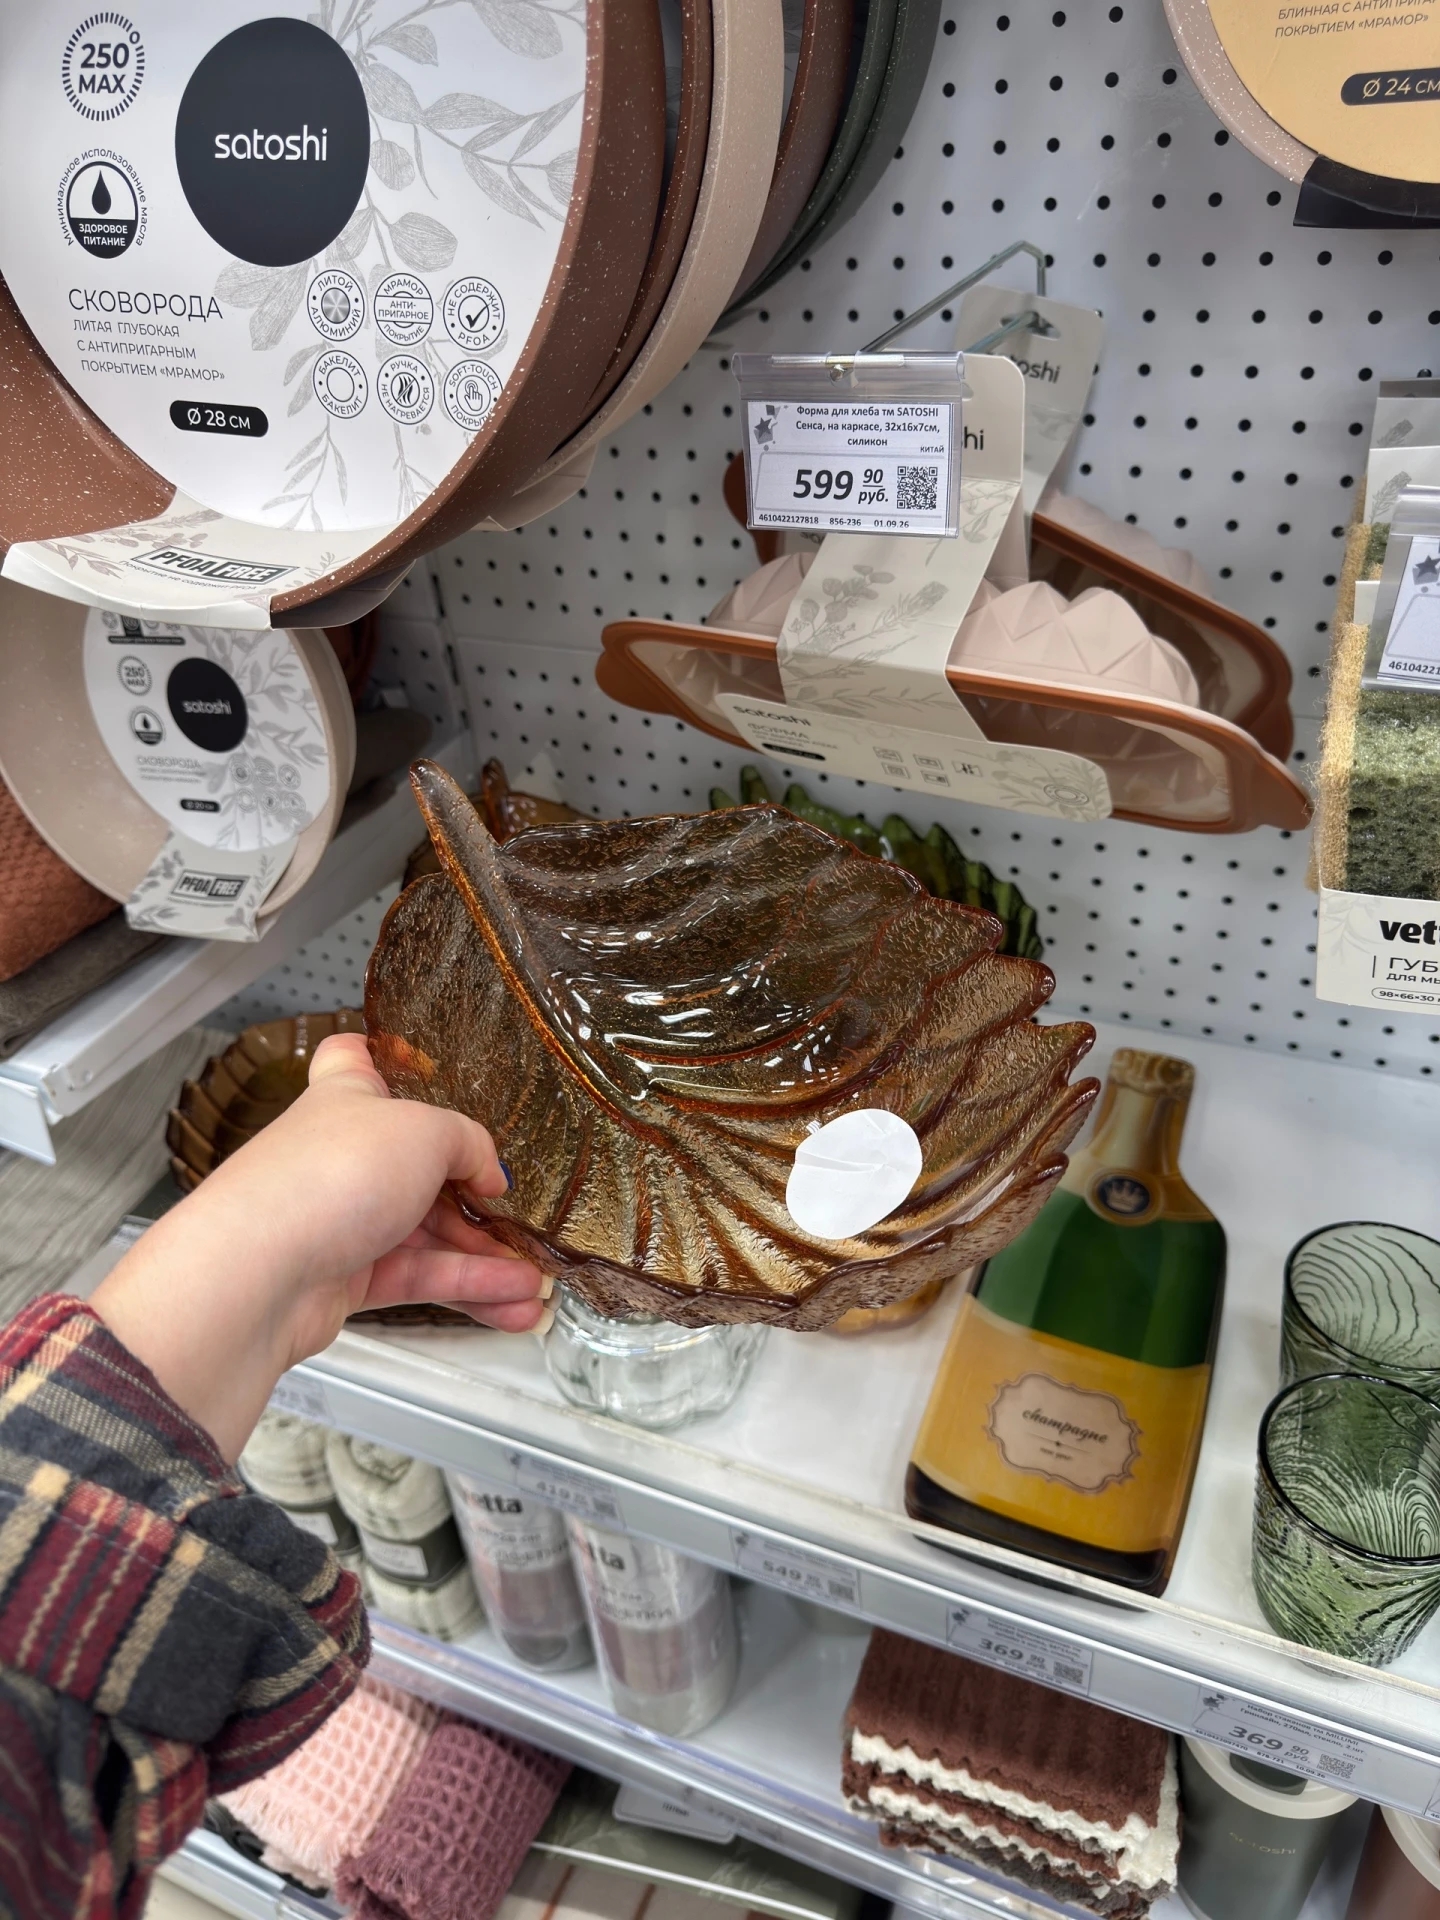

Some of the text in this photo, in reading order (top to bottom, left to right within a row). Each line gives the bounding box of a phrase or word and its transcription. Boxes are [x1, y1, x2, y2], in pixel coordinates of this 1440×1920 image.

[1278, 3, 1339, 20] БЛИННАЯ
[1274, 13, 1429, 38] ПОКРЫТИЕМ «МРАМОР»
[78, 73, 127, 94] MAX
[1384, 77, 1412, 96] 24
[214, 124, 328, 162] satoshi
[57, 148, 148, 247] Минимальное использование масла
[78, 223, 128, 234] ЗДОРОВОЕ
[83, 236, 126, 247] ПИТАНИЕ
[317, 274, 354, 292] ЛИТОЙ
[383, 278, 424, 296] МРАМОР
[68, 288, 224, 323] СКОВОРОДА
[389, 300, 417, 309] АНТИ-
[447, 282, 501, 320] НЕ СОДЕРЖИТ
[311, 306, 361, 338] АЛЮМИНИЙ
[378, 309, 429, 320] ПРИГАРНОЕ
[73, 319, 180, 338] ЛИТАЯ ГЛУБОКАЯ
[383, 323, 425, 342] ПОКРЫТИЕ
[457, 331, 491, 346] PFOA
[76, 339, 197, 360] С АНТИПРИГАРНЫМ
[80, 360, 225, 381] ПОКРЫТИЕМ «МРАМОР»
[318, 355, 361, 377] БАКЕЛИТ
[390, 360, 419, 374] РУЧКА
[450, 364, 499, 391] SOFT-TOUCH
[321, 393, 363, 415] БАКЕЛИТ
[380, 383, 431, 420] НЕ НАГРЕВАЕТСЯ
[204, 409, 227, 427] 28
[796, 406, 939, 418] Форма для хлеба тм SATOSHI
[796, 420, 826, 432] Сенса,
[827, 423, 840, 431] на
[841, 423, 883, 433] каркасе,
[847, 437, 888, 447] силикон
[919, 445, 945, 454] КИТАЙ
[792, 468, 884, 501] 599 90
[857, 489, 889, 505] руб.
[758, 514, 910, 529] 4610422127818 856-236 01.09.26
[149, 550, 279, 581] PFOA FREE
[182, 699, 232, 716] satoshi
[181, 875, 241, 896] PFOA FREE
[1379, 919, 1440, 946] vet
[1386, 973, 1417, 982] для
[1022, 1407, 1108, 1444] champagne
[763, 1559, 802, 1581] 549
[978, 1638, 1024, 1661] 369
[1228, 1725, 1310, 1756] 369 90
